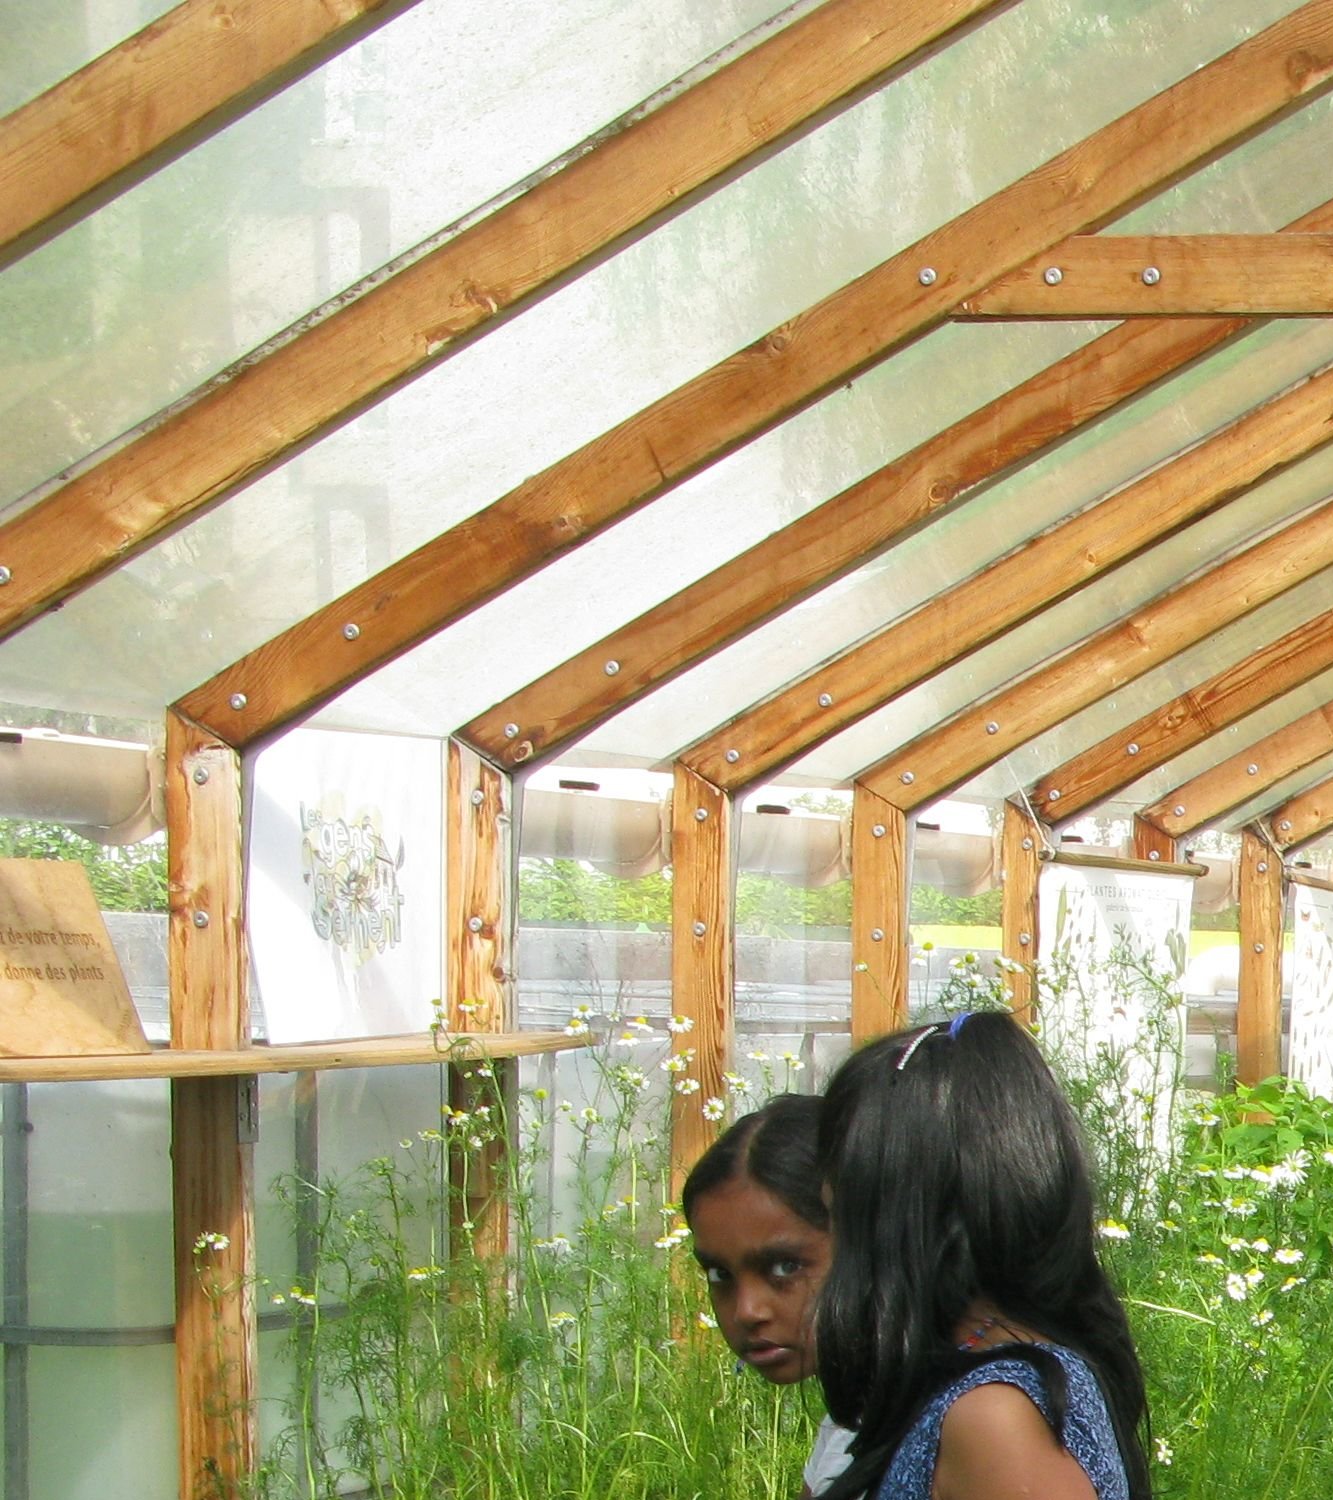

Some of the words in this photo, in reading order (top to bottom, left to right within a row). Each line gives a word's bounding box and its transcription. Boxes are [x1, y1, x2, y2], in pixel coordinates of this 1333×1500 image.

[1087, 885, 1117, 898] LANTES
[8, 928, 25, 945] de
[27, 930, 58, 946] votre
[60, 930, 101, 950] temps,
[5, 962, 45, 981] donne
[45, 962, 67, 981] des
[69, 962, 105, 984] plants
